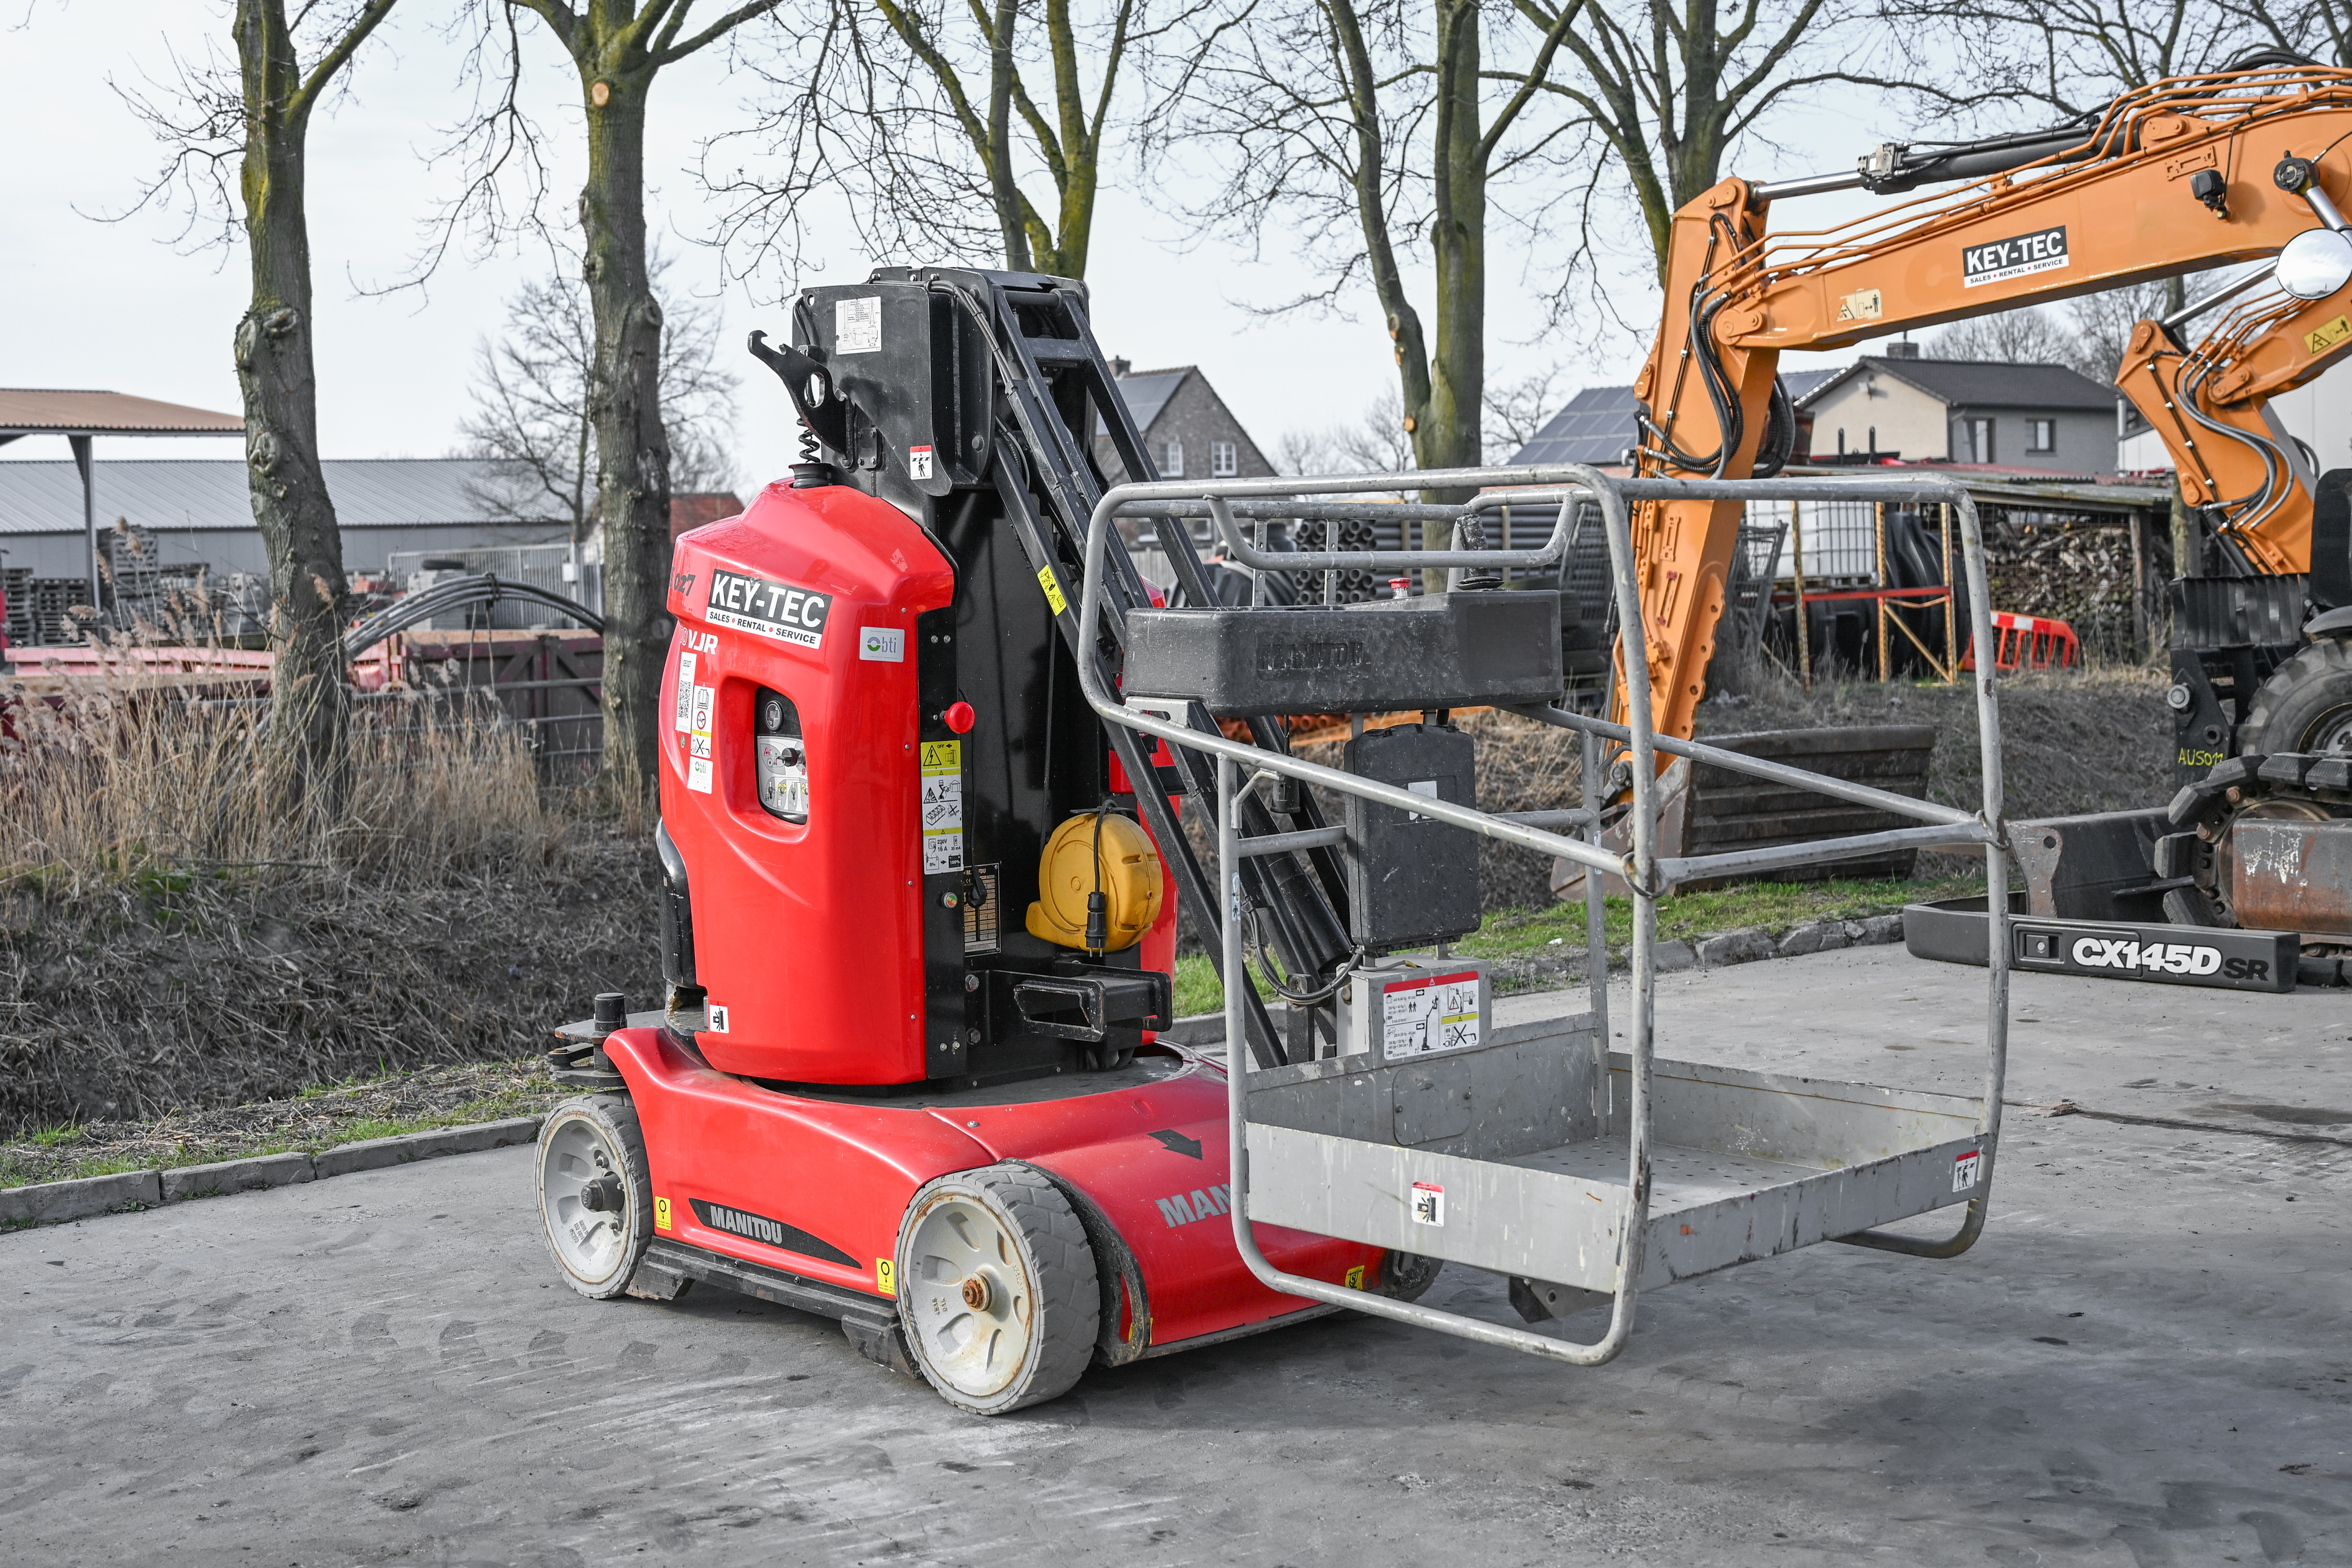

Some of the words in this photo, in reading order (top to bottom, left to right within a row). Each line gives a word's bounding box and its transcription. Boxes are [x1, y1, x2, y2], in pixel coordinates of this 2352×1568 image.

[1967, 232, 2062, 274] KEY-TEC
[1970, 274, 1991, 283] SALES
[1999, 267, 2025, 277] RENTAL
[2034, 259, 2063, 270] SERVICE
[674, 573, 696, 597] 027
[711, 573, 825, 627] KEY-TEC
[709, 611, 730, 623] SALES
[737, 618, 766, 632] RENTAL
[775, 628, 816, 644] SERVICE
[1258, 642, 1363, 670] MANITOU
[2072, 937, 2221, 975] CX145D
[2223, 957, 2269, 981] SR
[710, 1205, 782, 1244] MANITOU
